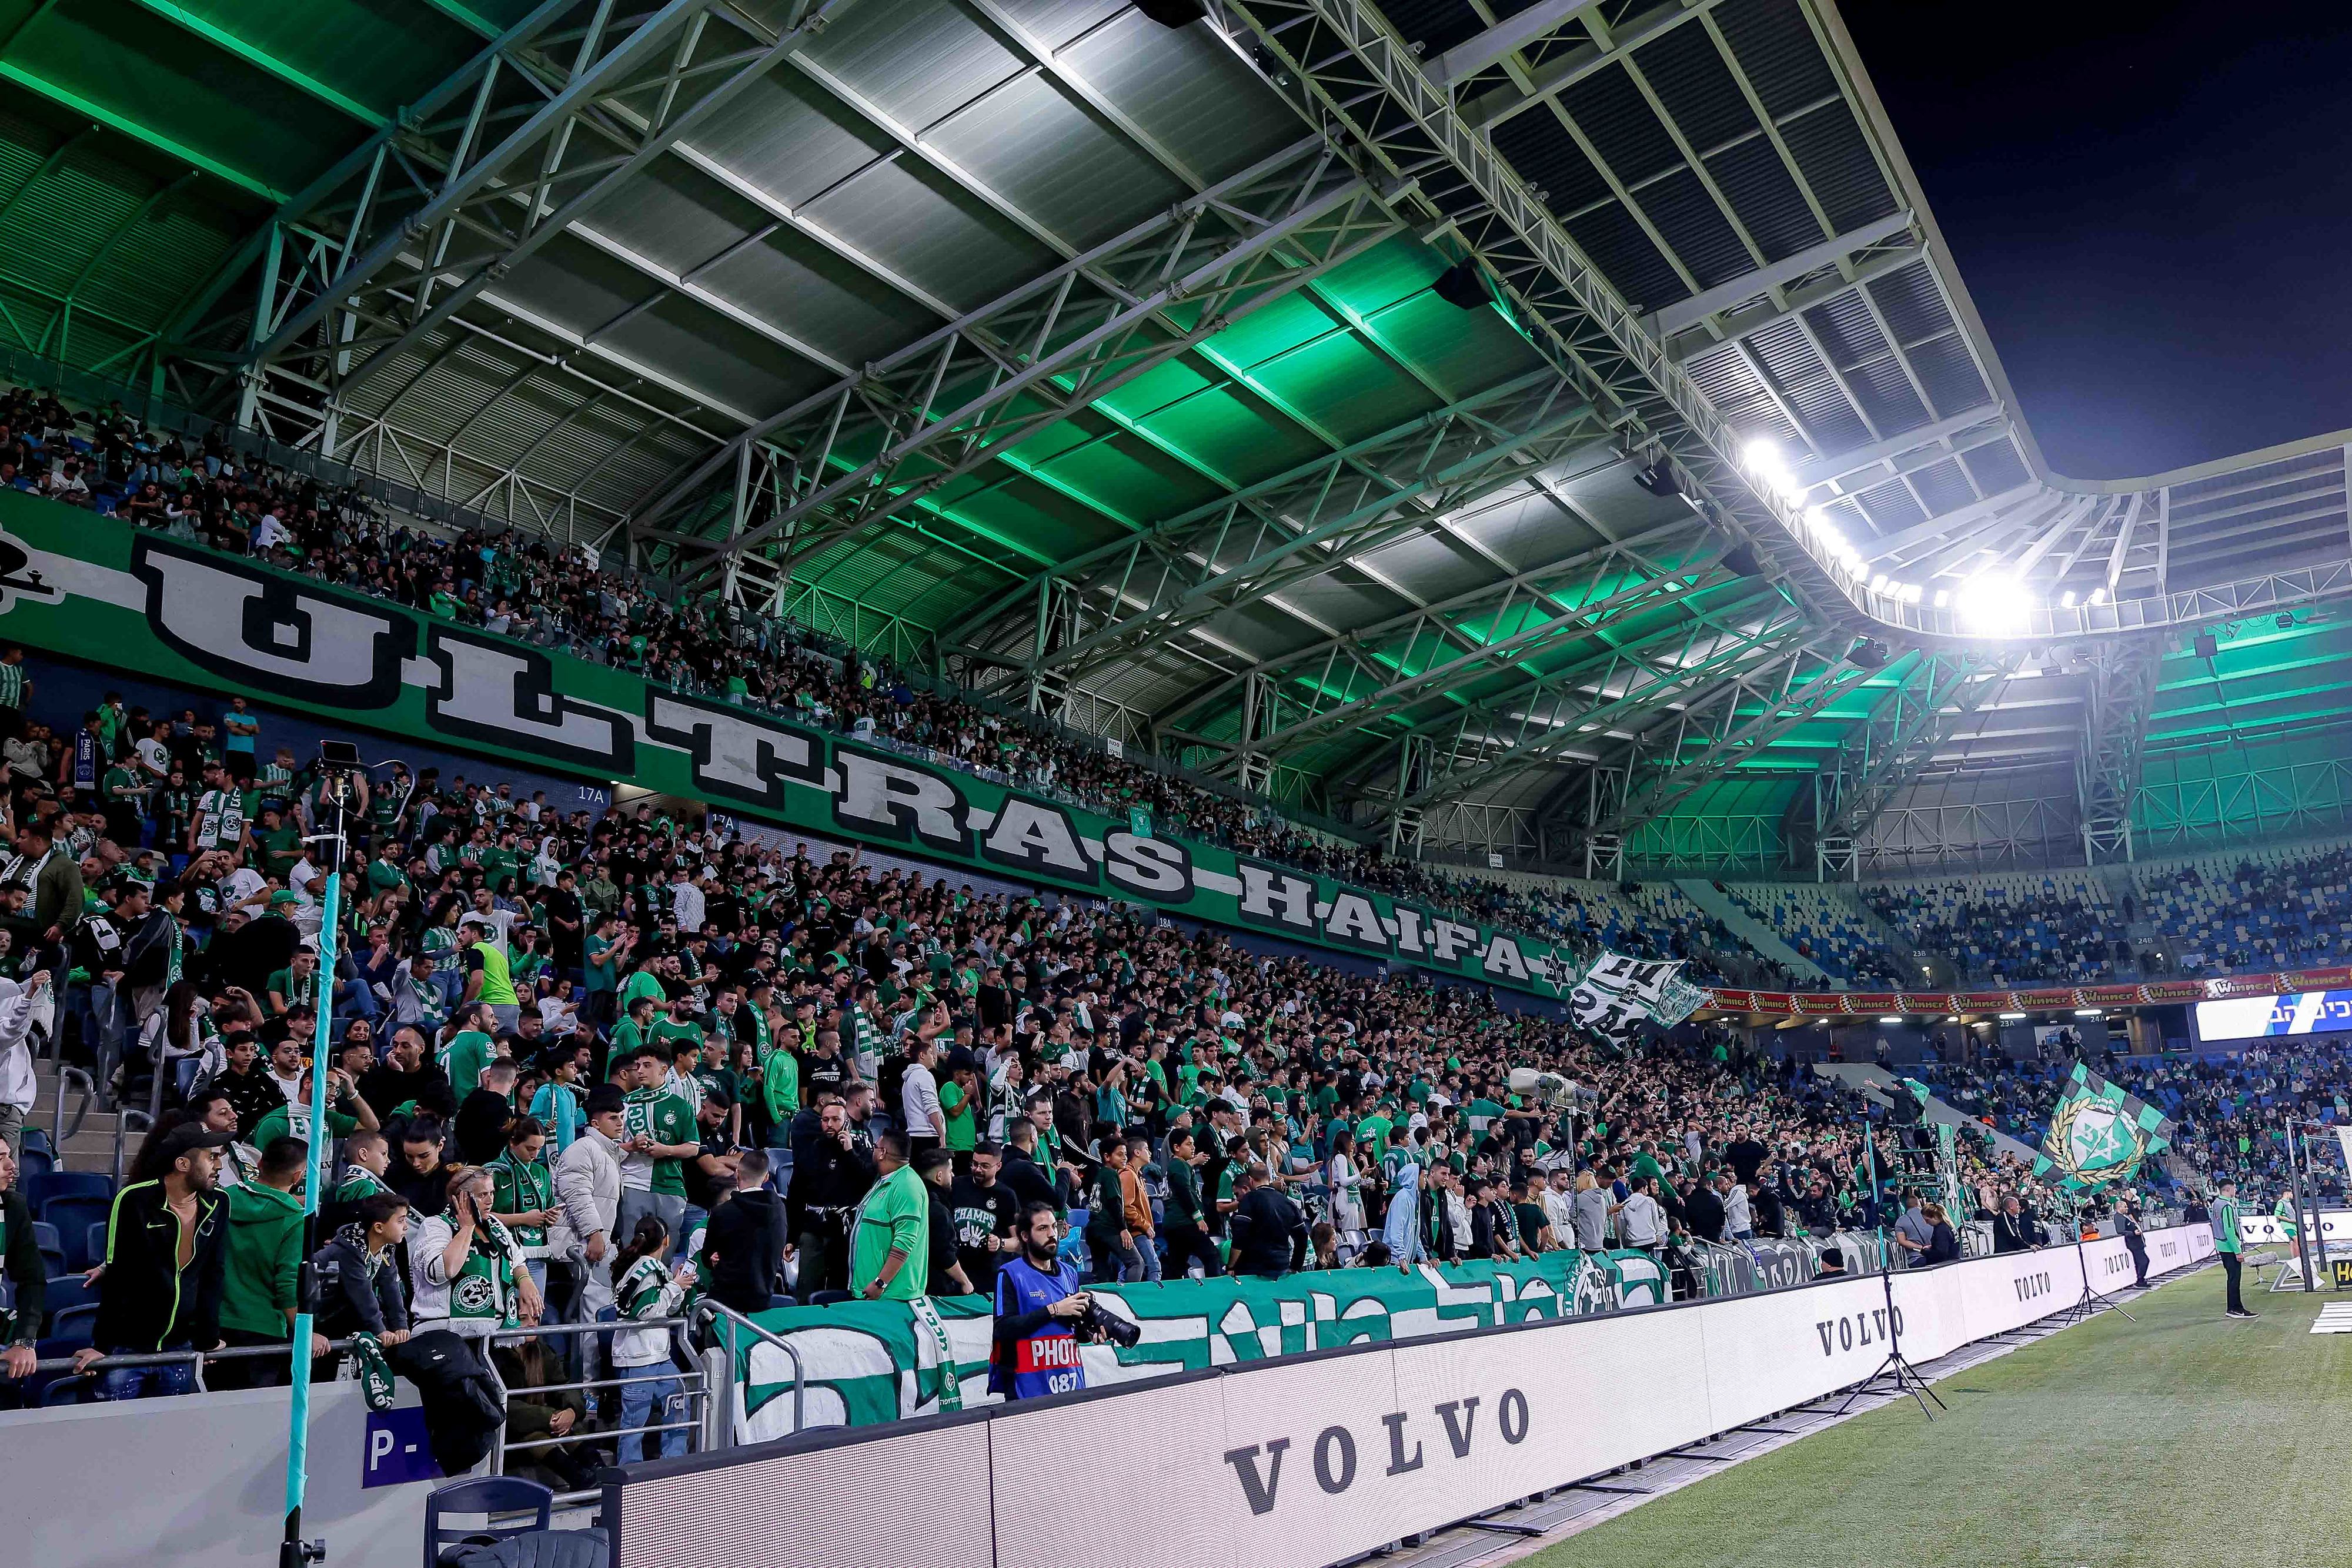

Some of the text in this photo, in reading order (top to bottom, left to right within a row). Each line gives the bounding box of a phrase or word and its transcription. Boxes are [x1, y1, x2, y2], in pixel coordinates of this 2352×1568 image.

[133, 536, 1532, 987] ULTRAS HAIFA
[579, 785, 604, 804] 17A
[712, 813, 734, 830] 17A
[1091, 899, 1105, 912] 18A
[1160, 917, 1172, 929] 18A
[1378, 966, 1387, 976] 19A
[954, 1207, 997, 1229] CHAMPS
[2243, 1222, 2334, 1234] VOVO
[2014, 1271, 2051, 1302] VOLVO
[1816, 1305, 1903, 1356] VOLVO
[1048, 1372, 1077, 1395] 087
[370, 1429, 395, 1471] P
[1223, 1388, 1530, 1517] VOLVO
